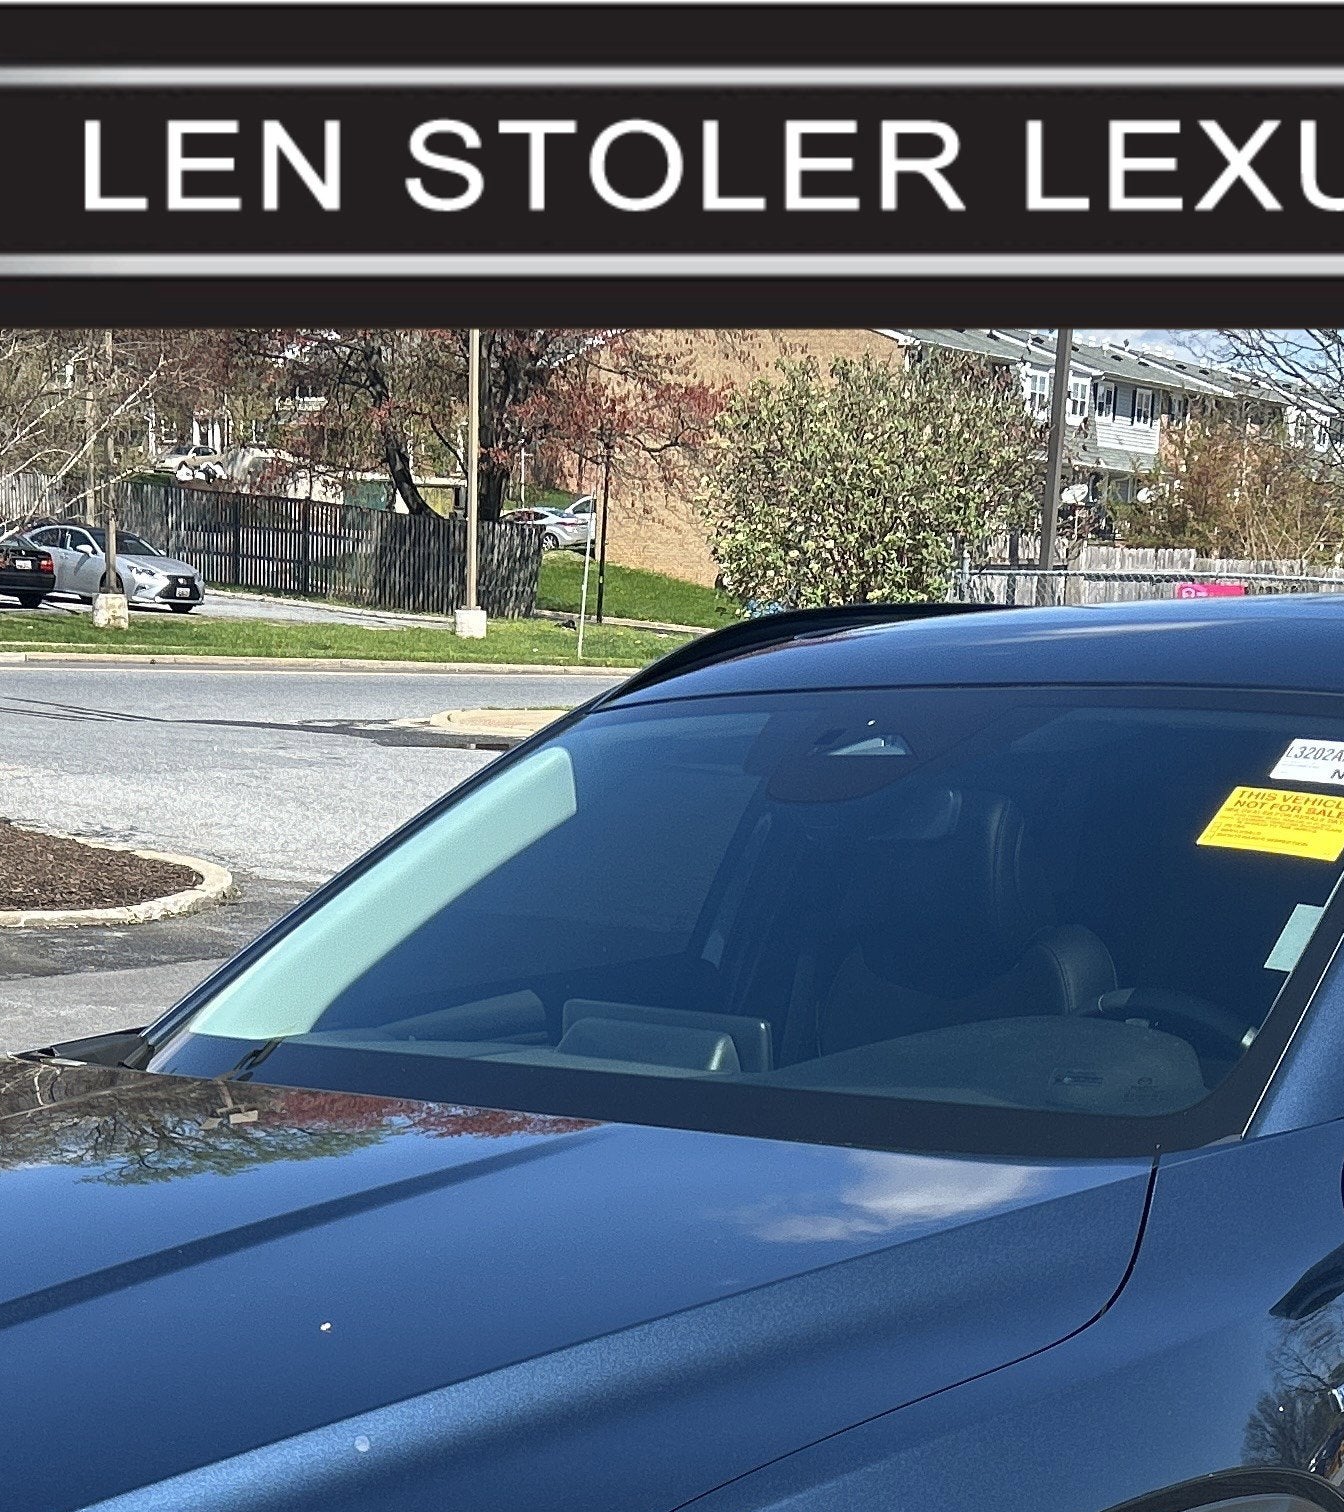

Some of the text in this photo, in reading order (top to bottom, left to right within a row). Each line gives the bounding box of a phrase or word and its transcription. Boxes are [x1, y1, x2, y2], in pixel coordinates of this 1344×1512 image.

[1239, 790, 1278, 802] THIS
[1233, 800, 1269, 810] NOT
[1270, 803, 1302, 814] FOR
